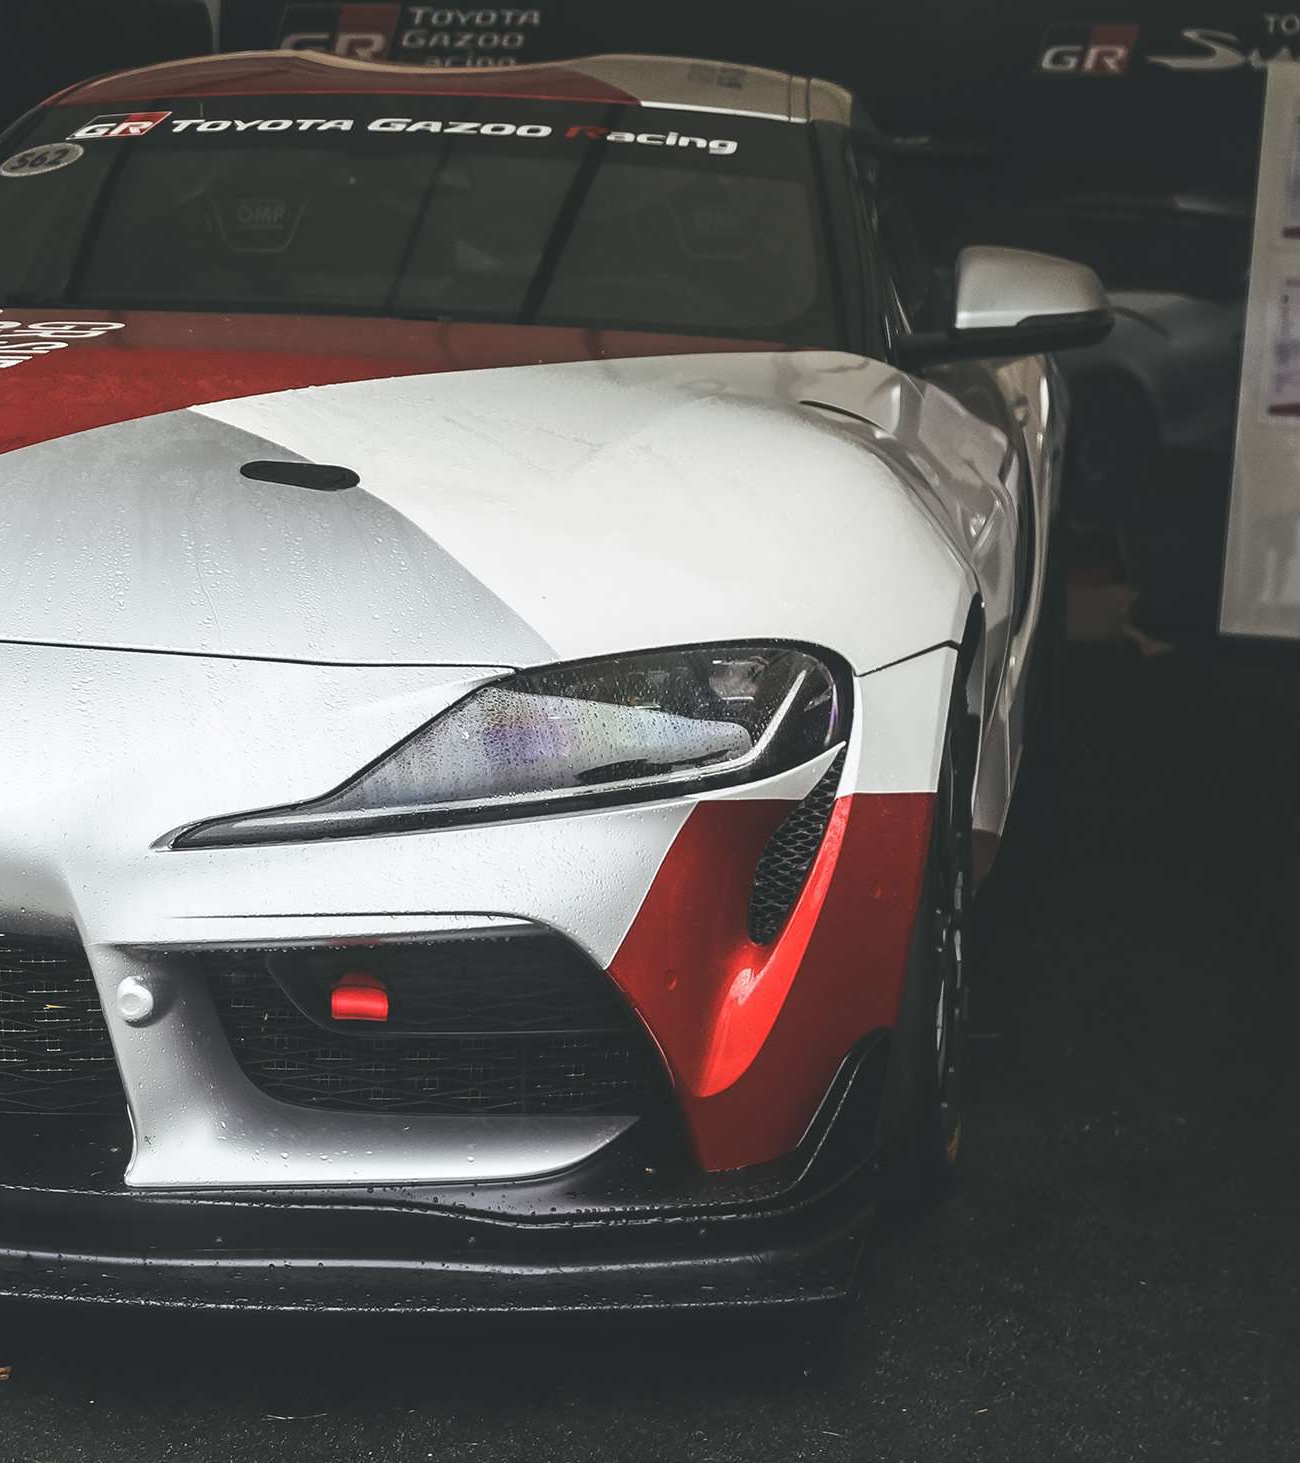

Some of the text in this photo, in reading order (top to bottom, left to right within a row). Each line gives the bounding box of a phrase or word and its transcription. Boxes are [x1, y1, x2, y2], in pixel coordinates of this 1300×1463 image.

[409, 6, 541, 27] TOYOTA
[402, 30, 525, 49] GAZOO
[1041, 45, 1126, 72] GR
[74, 118, 738, 156] GR TOYOTA GAZOO Racing
[9, 147, 70, 171] 562
[0, 320, 127, 339] GR
